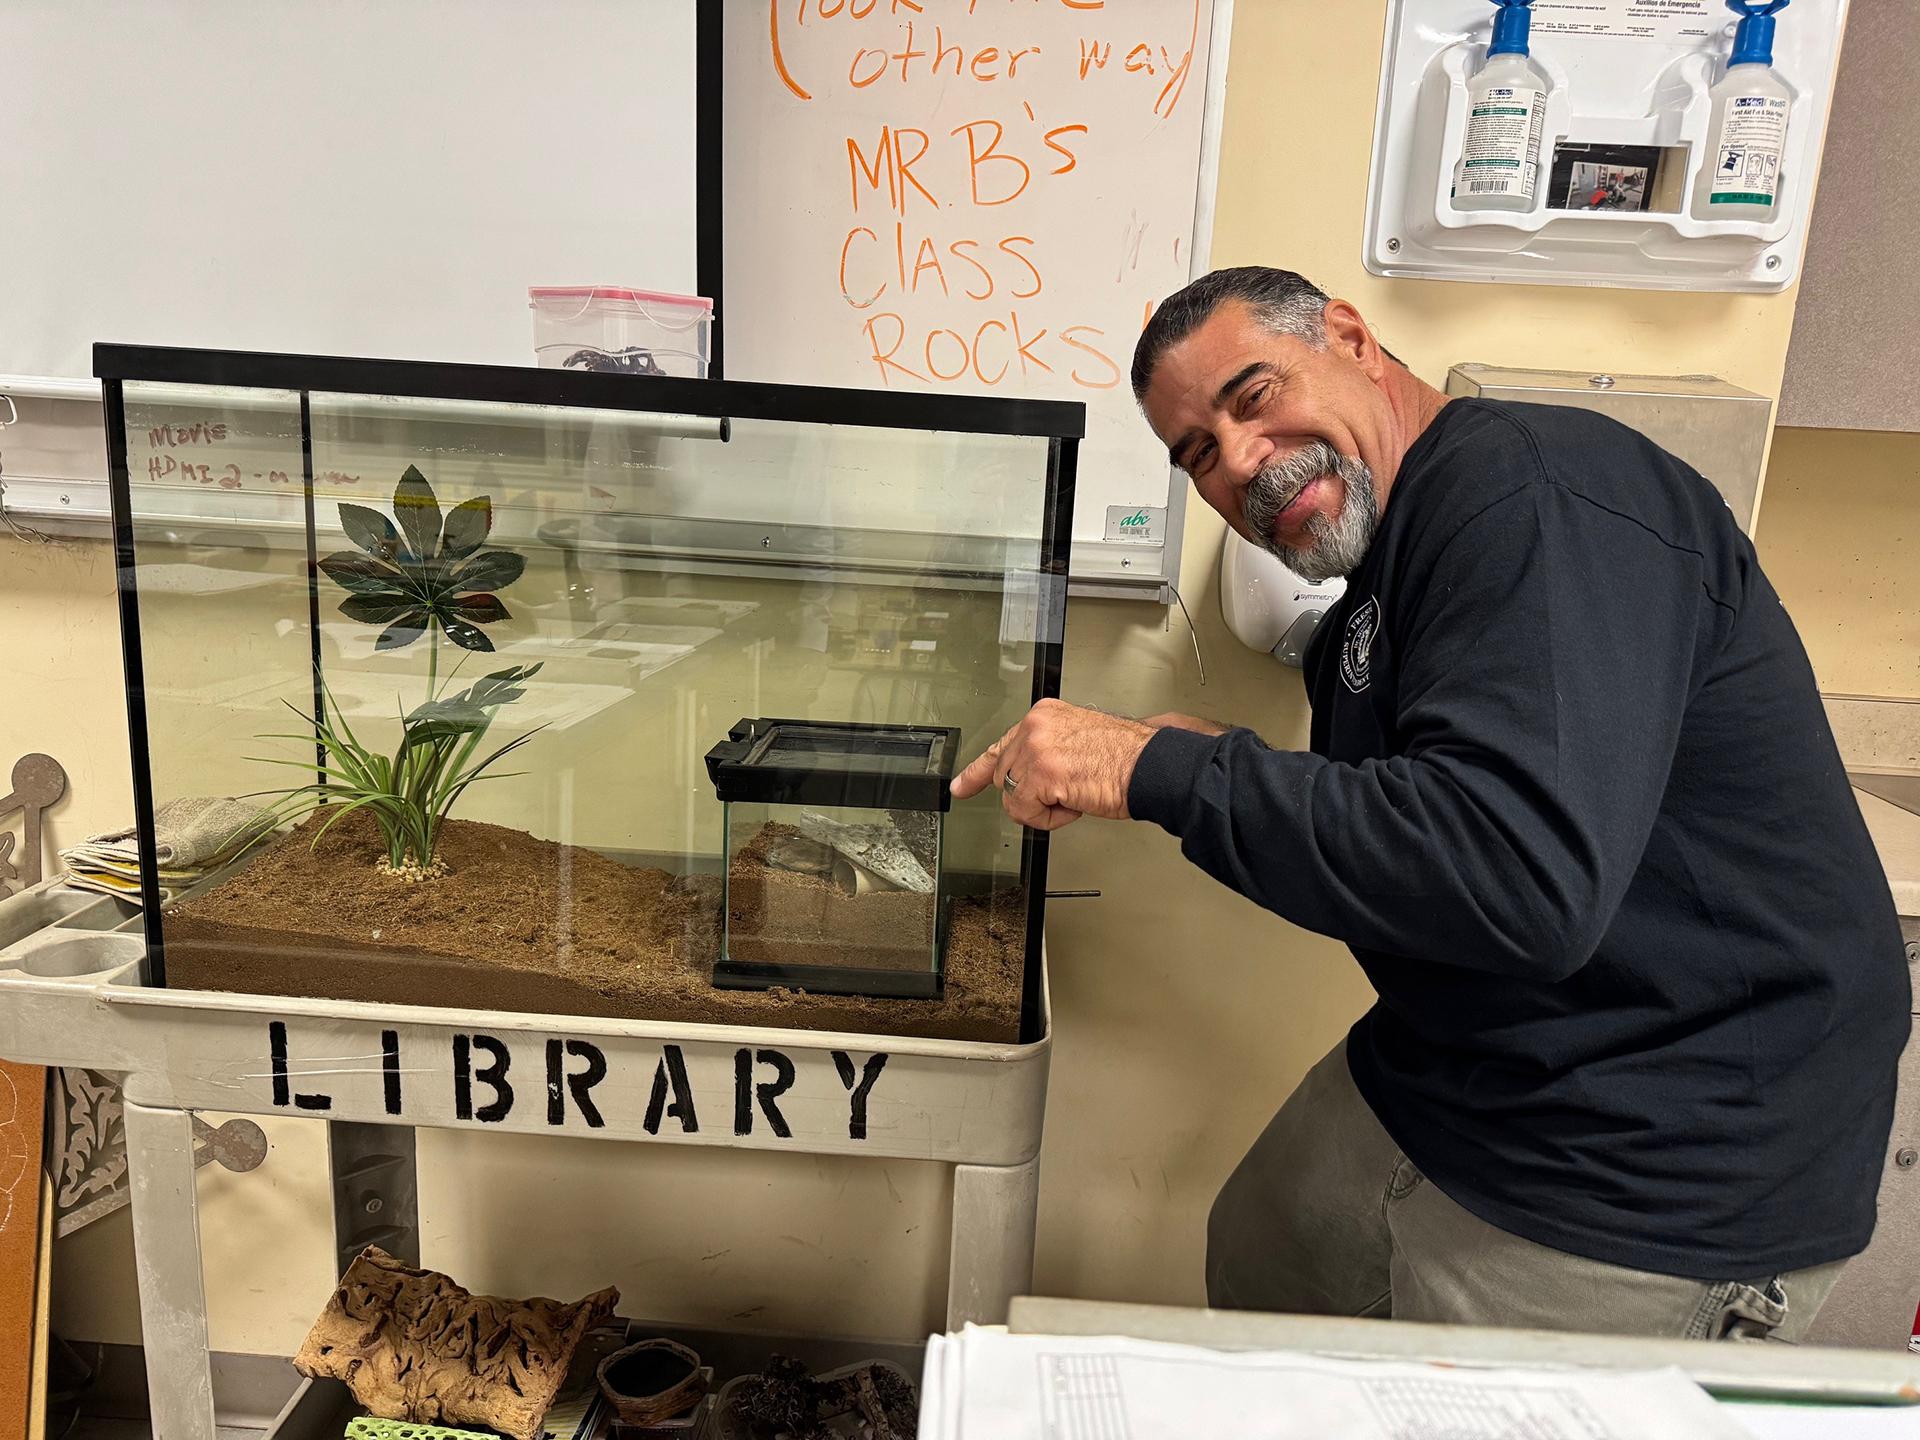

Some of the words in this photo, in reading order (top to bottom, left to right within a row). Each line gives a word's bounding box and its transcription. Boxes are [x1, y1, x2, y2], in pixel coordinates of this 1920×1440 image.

[849, 21, 1041, 89] other
[1120, 509, 1151, 526] abc
[269, 1021, 889, 1140] LIBRARY
